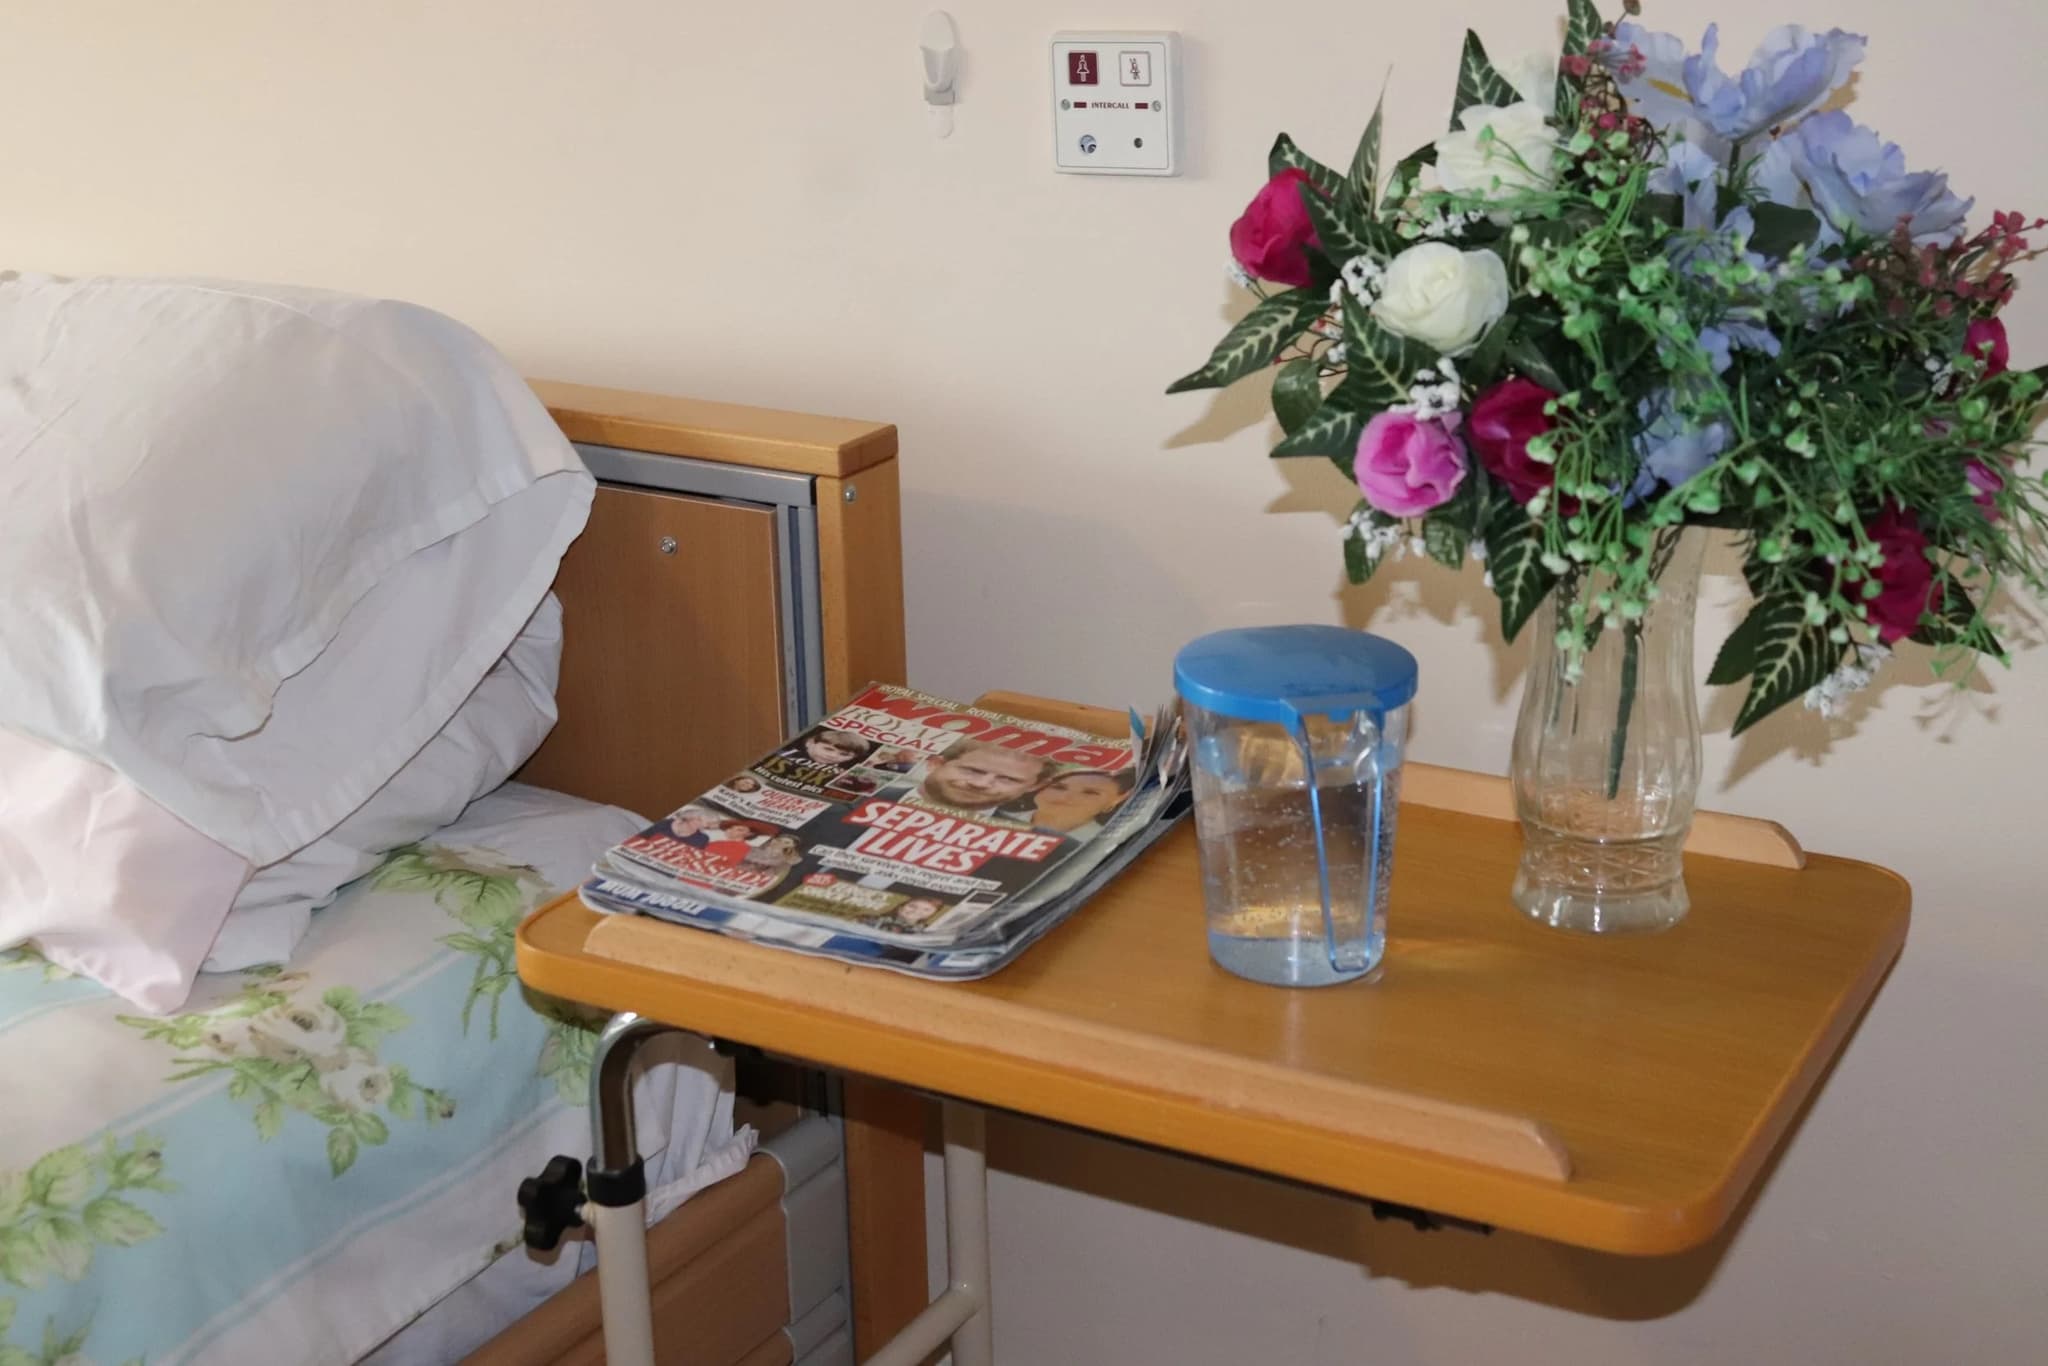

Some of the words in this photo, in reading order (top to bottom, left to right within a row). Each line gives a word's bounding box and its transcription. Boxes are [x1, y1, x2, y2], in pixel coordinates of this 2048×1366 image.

[880, 685, 915, 697] ROYAL
[917, 693, 960, 710] SPECIAL
[967, 707, 1002, 720] ROYAL
[827, 716, 938, 753] SPECIAL
[841, 706, 950, 743] ROYAL
[770, 774, 803, 789] cutest
[800, 784, 824, 794] pics
[851, 801, 1057, 858] SEPARATE
[651, 836, 727, 866] BEST
[866, 828, 986, 872] LIVES
[860, 855, 900, 868] survive
[900, 863, 918, 874] his
[956, 876, 976, 886] and
[901, 874, 930, 888] royal
